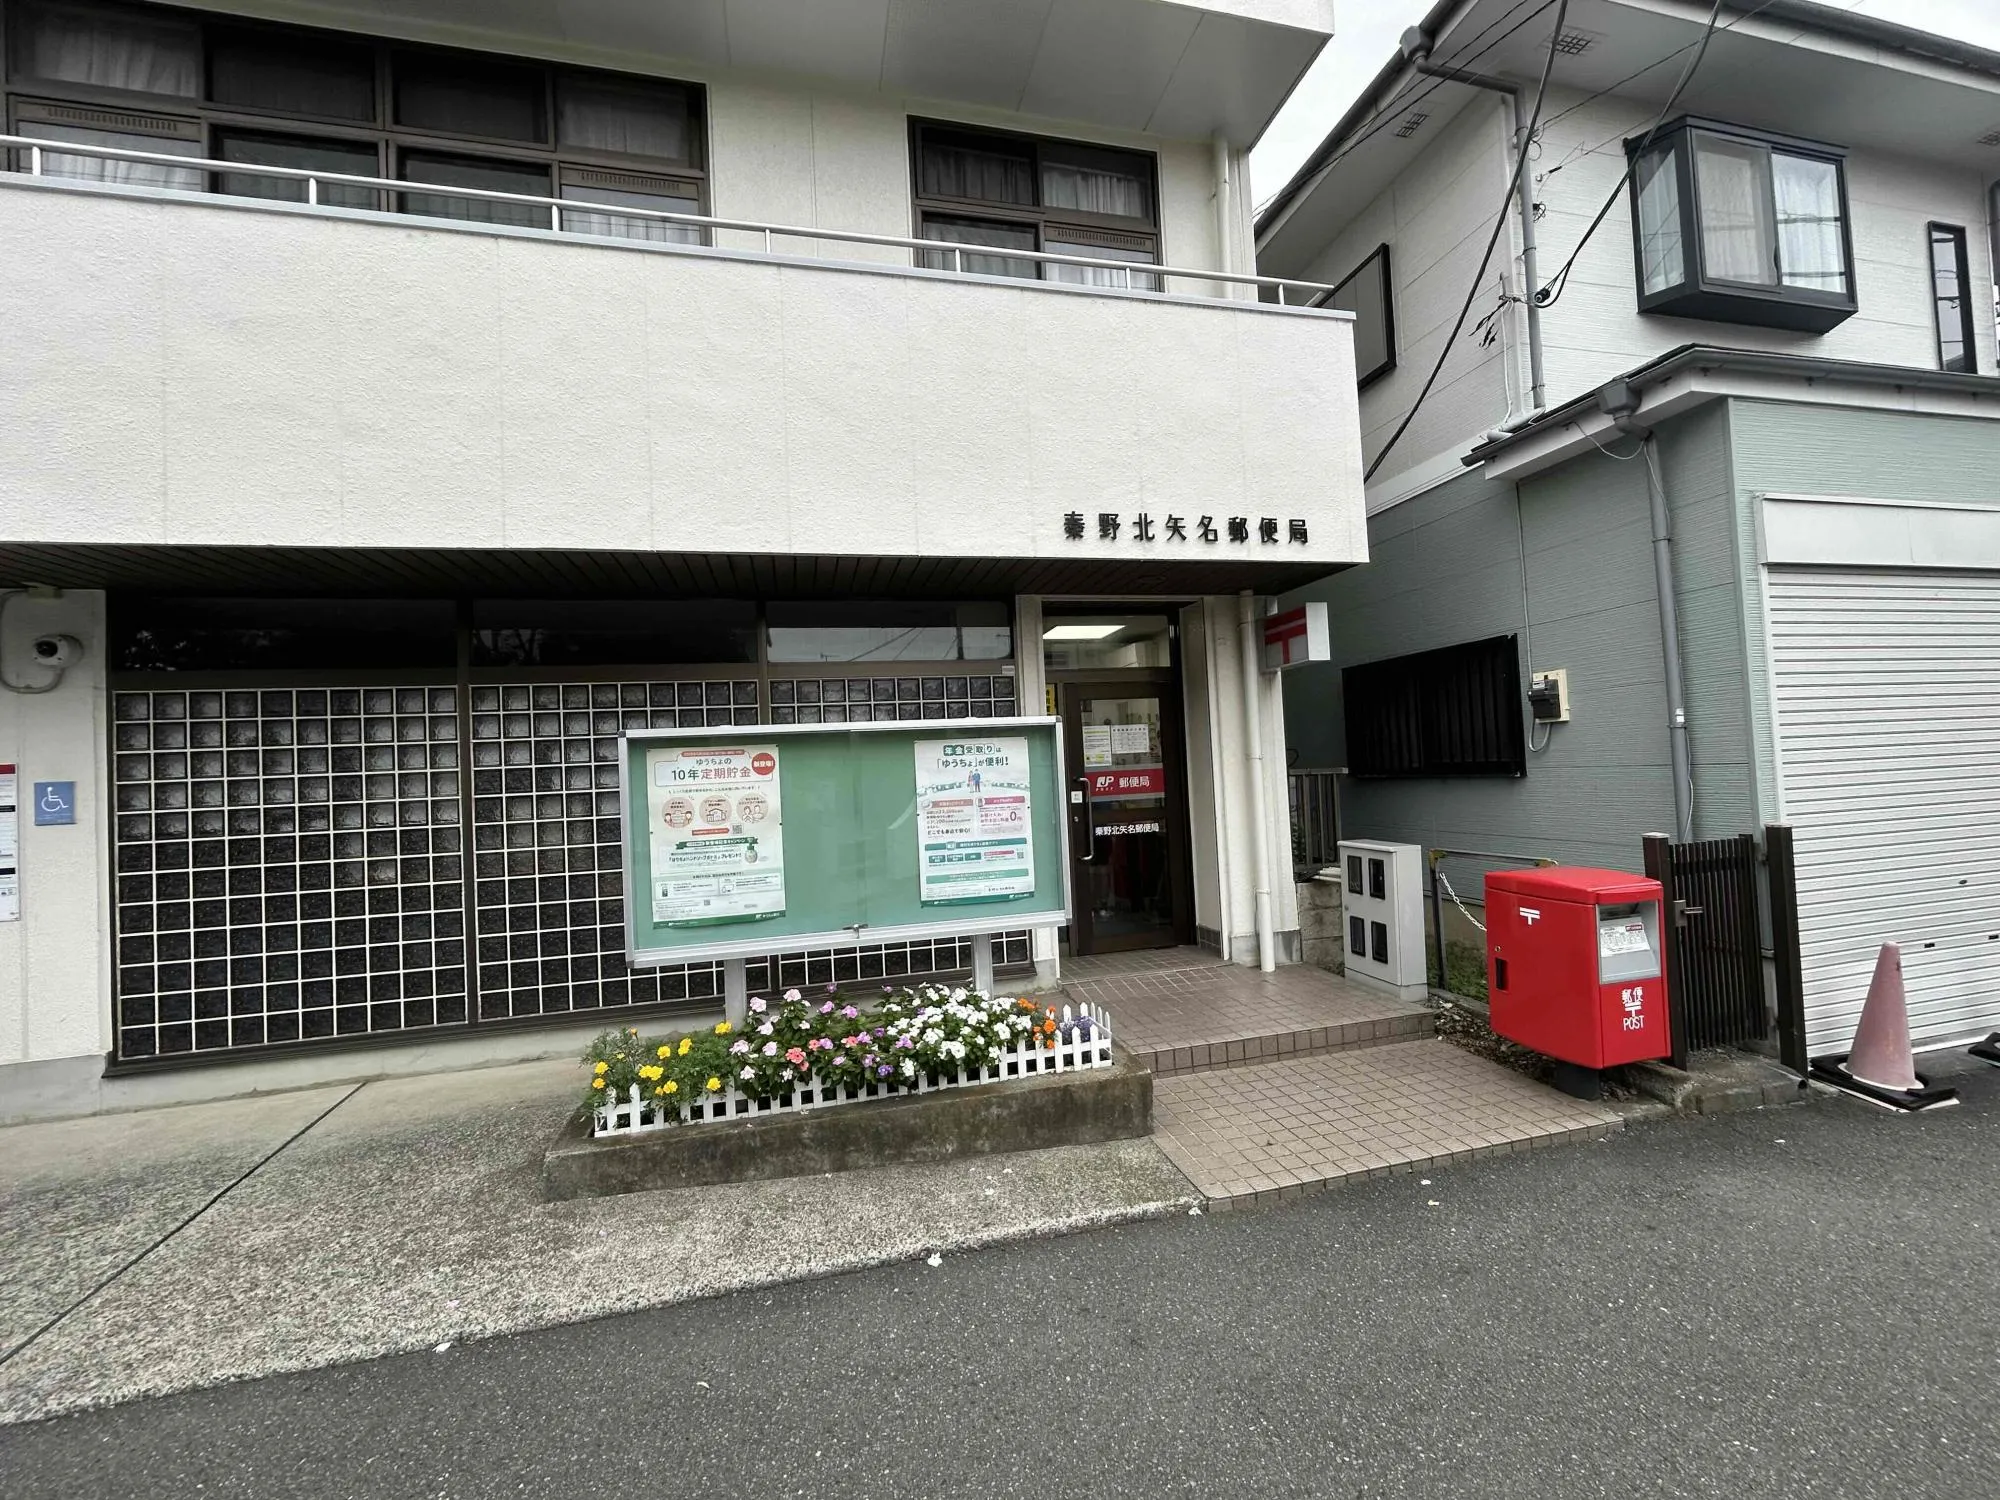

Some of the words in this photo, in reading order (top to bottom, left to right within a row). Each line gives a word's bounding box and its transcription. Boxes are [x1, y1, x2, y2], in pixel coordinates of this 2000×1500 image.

[1063, 511, 1309, 545] 秦野北矢名郵便局
[944, 745, 1002, 756] 年金受取りは
[696, 757, 732, 766] ゆうちょの
[937, 756, 1009, 768] 「ゆうちょ」が便利!
[671, 766, 751, 781] 10年定期貯金
[1119, 776, 1150, 788] 郵便局
[1095, 822, 1160, 836] 秦野北矢名郵便局
[1621, 986, 1644, 1004] 郵便
[1622, 1015, 1645, 1031] POST
